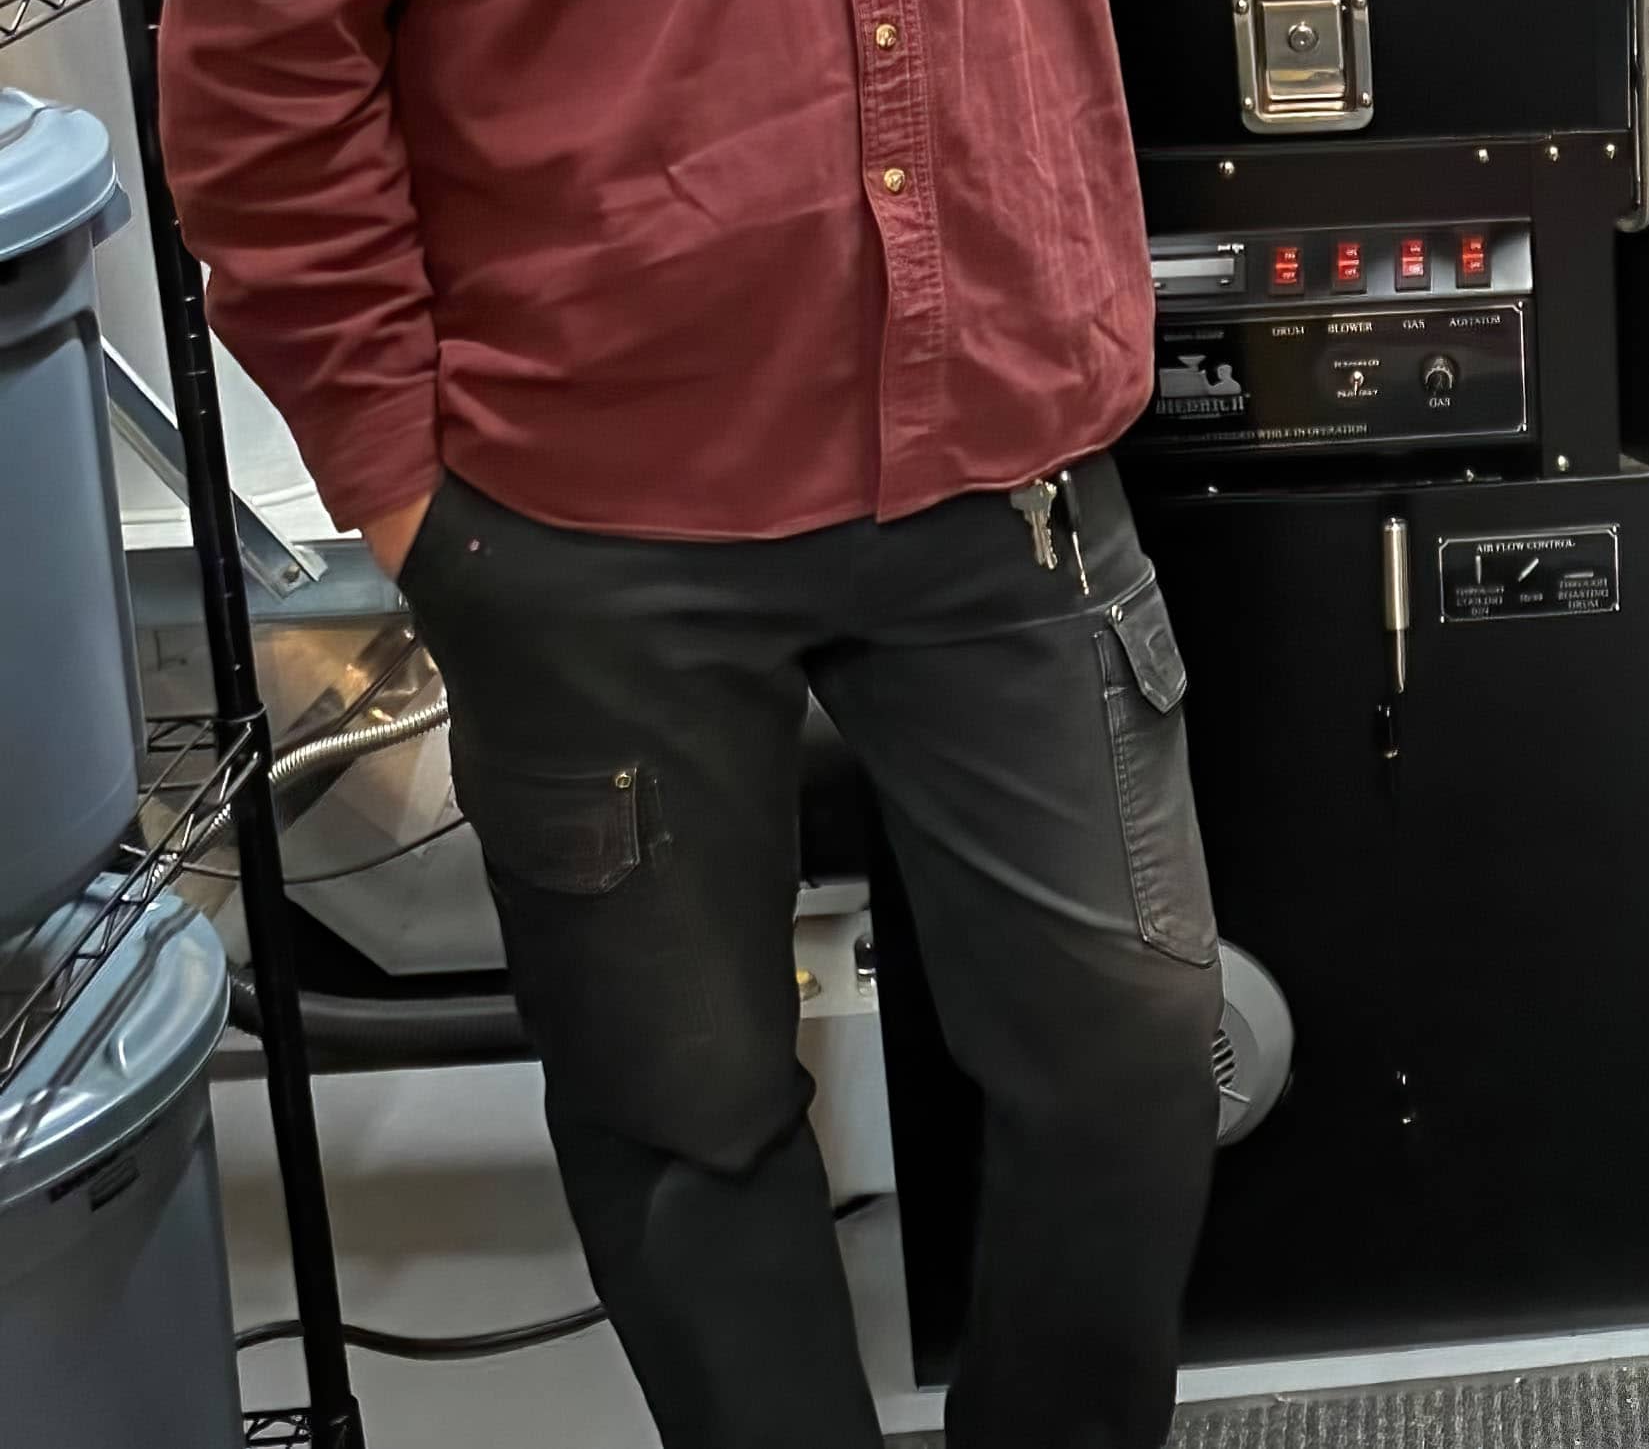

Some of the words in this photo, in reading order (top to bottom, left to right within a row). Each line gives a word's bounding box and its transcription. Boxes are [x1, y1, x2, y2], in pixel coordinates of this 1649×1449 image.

[1327, 321, 1373, 334] BLOWER
[1402, 318, 1425, 330] GAS
[1272, 327, 1305, 337] DRUM
[1429, 397, 1451, 408] GAS
[1477, 543, 1494, 553] AIR
[1496, 541, 1524, 552] FLOW
[1526, 538, 1576, 551] CONTROL
[1558, 589, 1609, 600] ROASTING
[1568, 600, 1600, 610] DRUM
